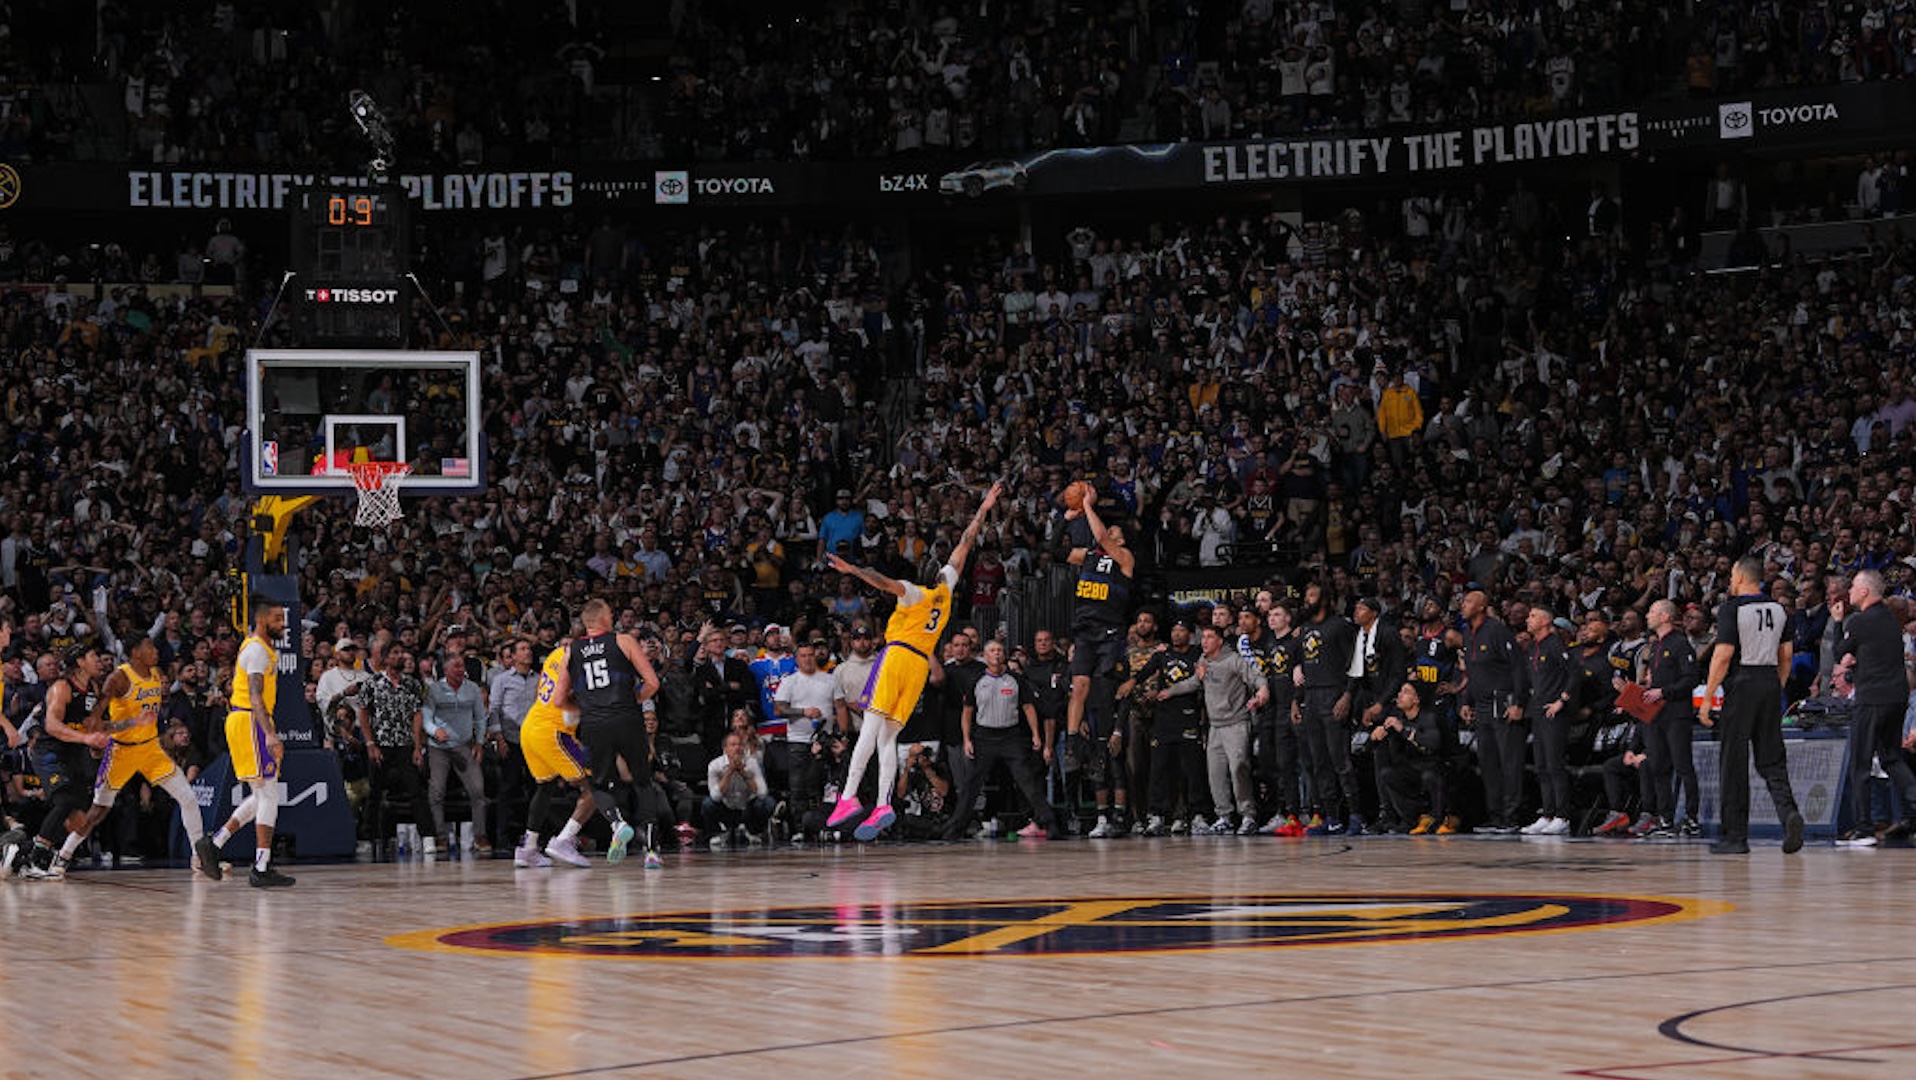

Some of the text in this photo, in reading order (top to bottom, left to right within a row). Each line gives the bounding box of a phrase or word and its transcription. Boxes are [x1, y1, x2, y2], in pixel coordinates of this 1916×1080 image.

[1758, 103, 1839, 126] TOYOTA
[1203, 112, 1640, 183] ELECTRIFY THE PLAYOFFS
[129, 171, 315, 209] ELECTRIFY
[399, 172, 573, 210] PLAYOFFS
[694, 178, 774, 194] TOYOTA
[879, 174, 928, 192] bZ4X
[328, 197, 373, 225] 0.9
[331, 289, 398, 303] TISSOT
[1075, 580, 1110, 601] 5280
[925, 608, 942, 631] 3
[1756, 608, 1774, 632] 74
[1428, 641, 1438, 657] 9
[583, 658, 610, 690] 15
[539, 672, 555, 703] 23
